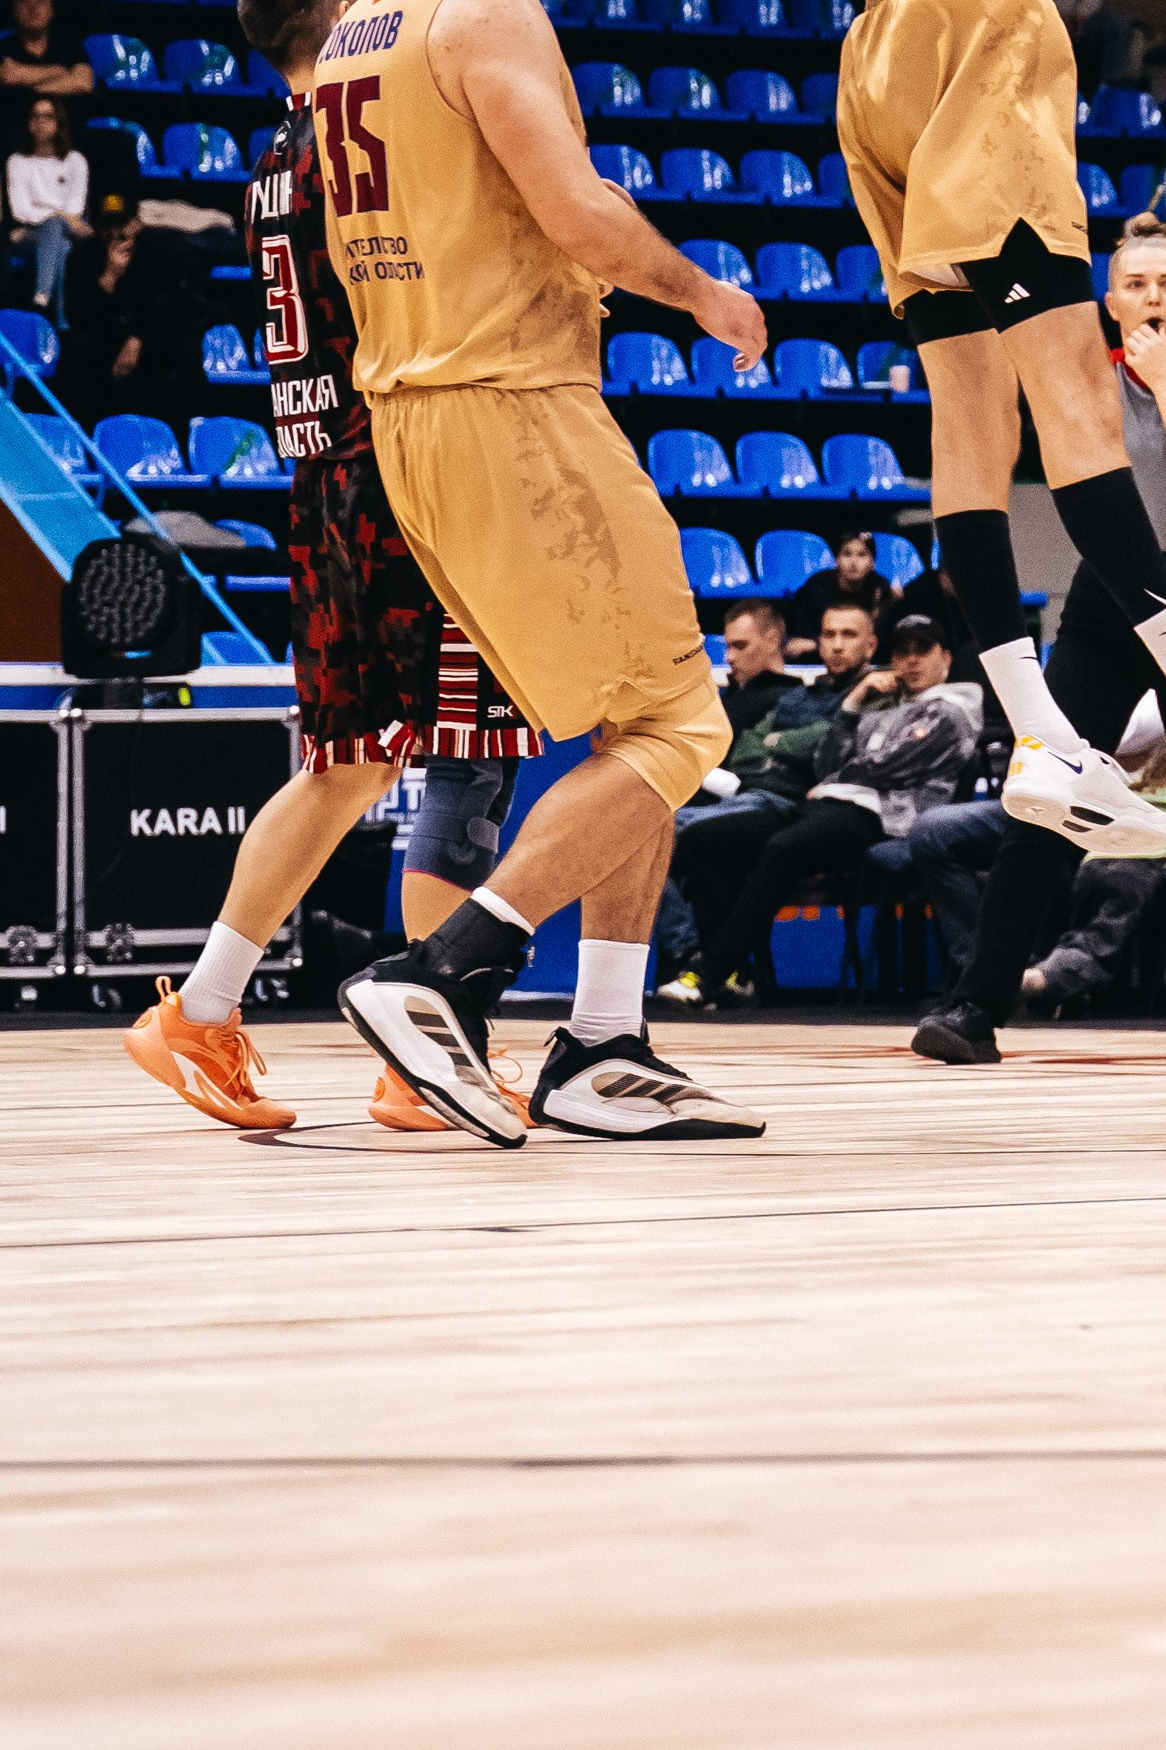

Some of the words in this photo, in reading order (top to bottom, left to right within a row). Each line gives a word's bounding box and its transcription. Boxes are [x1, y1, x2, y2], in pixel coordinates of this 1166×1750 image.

[319, 11, 403, 65] ОКОЛОВ
[315, 75, 390, 218] 35
[262, 234, 309, 365] 3
[130, 807, 221, 837] KARA
[227, 806, 246, 834] II
